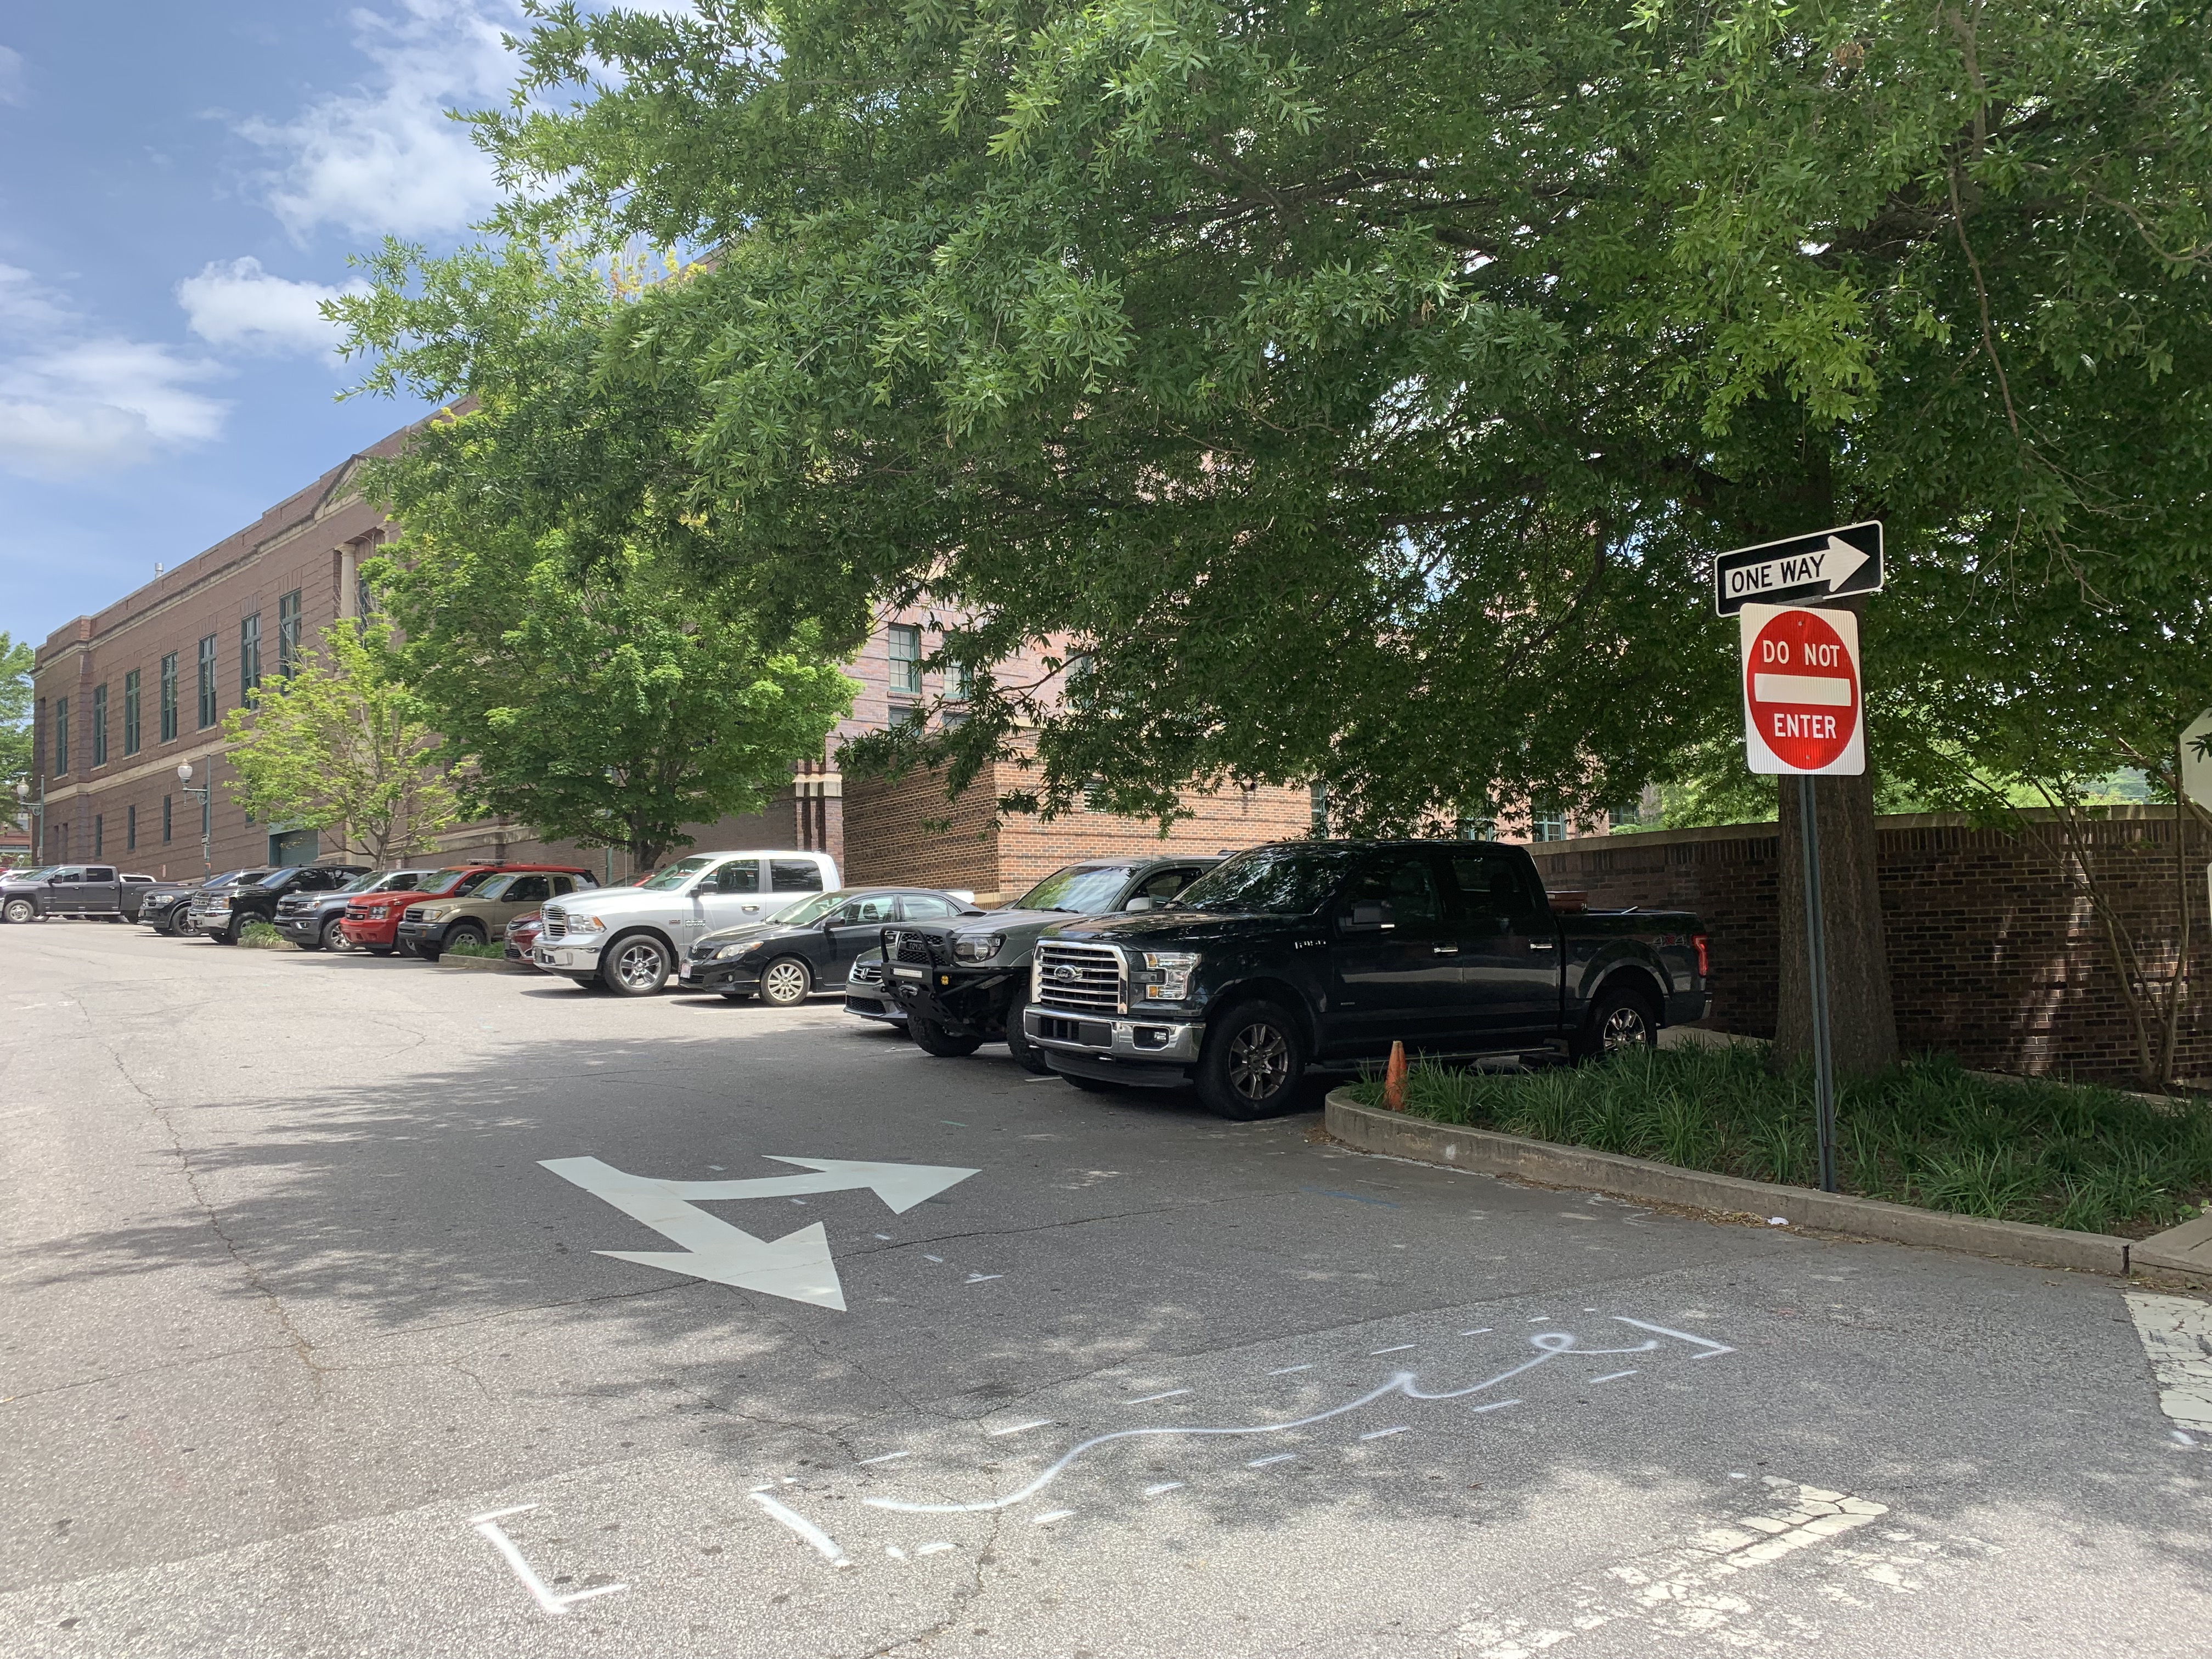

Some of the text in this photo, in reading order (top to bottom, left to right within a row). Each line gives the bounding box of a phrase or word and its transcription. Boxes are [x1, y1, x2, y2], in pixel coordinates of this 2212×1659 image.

[1732, 554, 1826, 593] ONE WAY
[1763, 640, 1840, 667] DO NOT
[1774, 713, 1837, 739] ENTER
